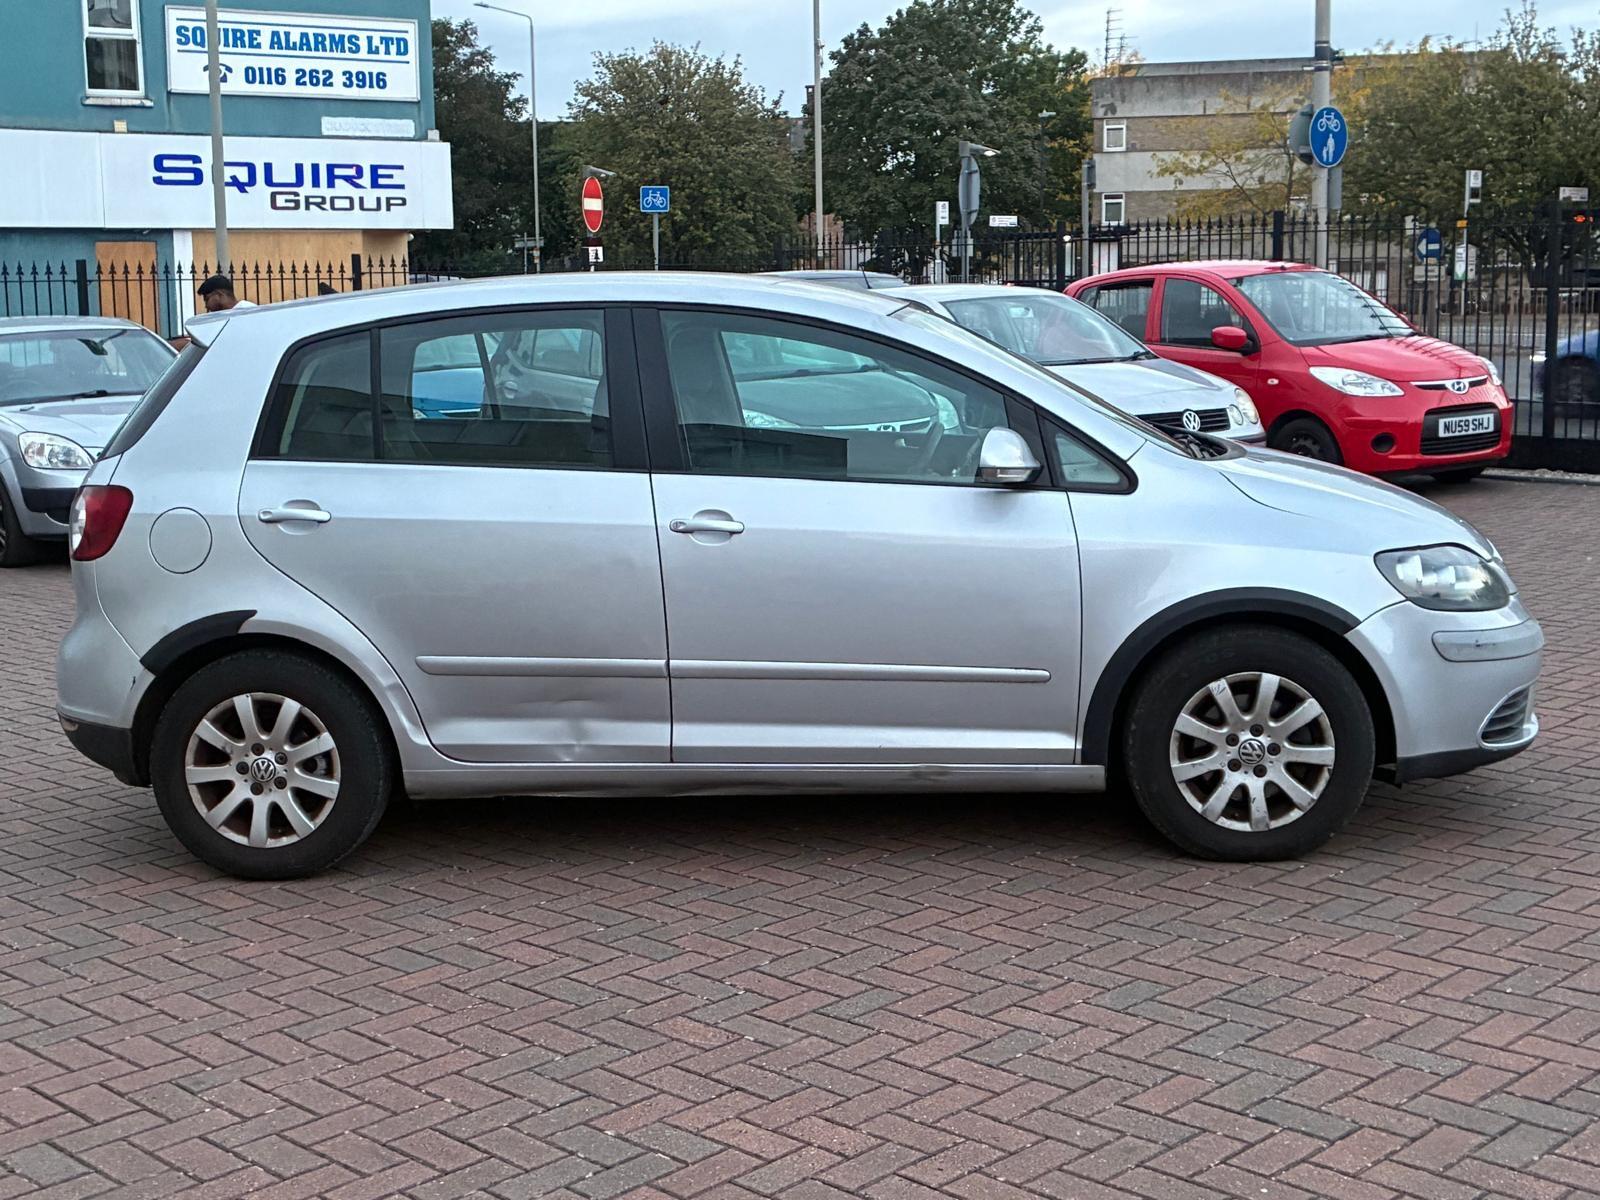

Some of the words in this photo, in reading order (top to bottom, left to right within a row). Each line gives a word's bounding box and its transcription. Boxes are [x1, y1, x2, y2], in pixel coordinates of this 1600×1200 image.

[176, 25, 262, 49] SQIRE
[269, 30, 361, 54] ALARMS
[366, 35, 409, 56] LTD
[244, 66, 287, 86] 0116
[295, 68, 333, 87] 262
[342, 70, 387, 89] 3916
[152, 154, 406, 193] SQUIRE
[1443, 419, 1470, 435] NU59
[1471, 416, 1490, 431] SHJ
